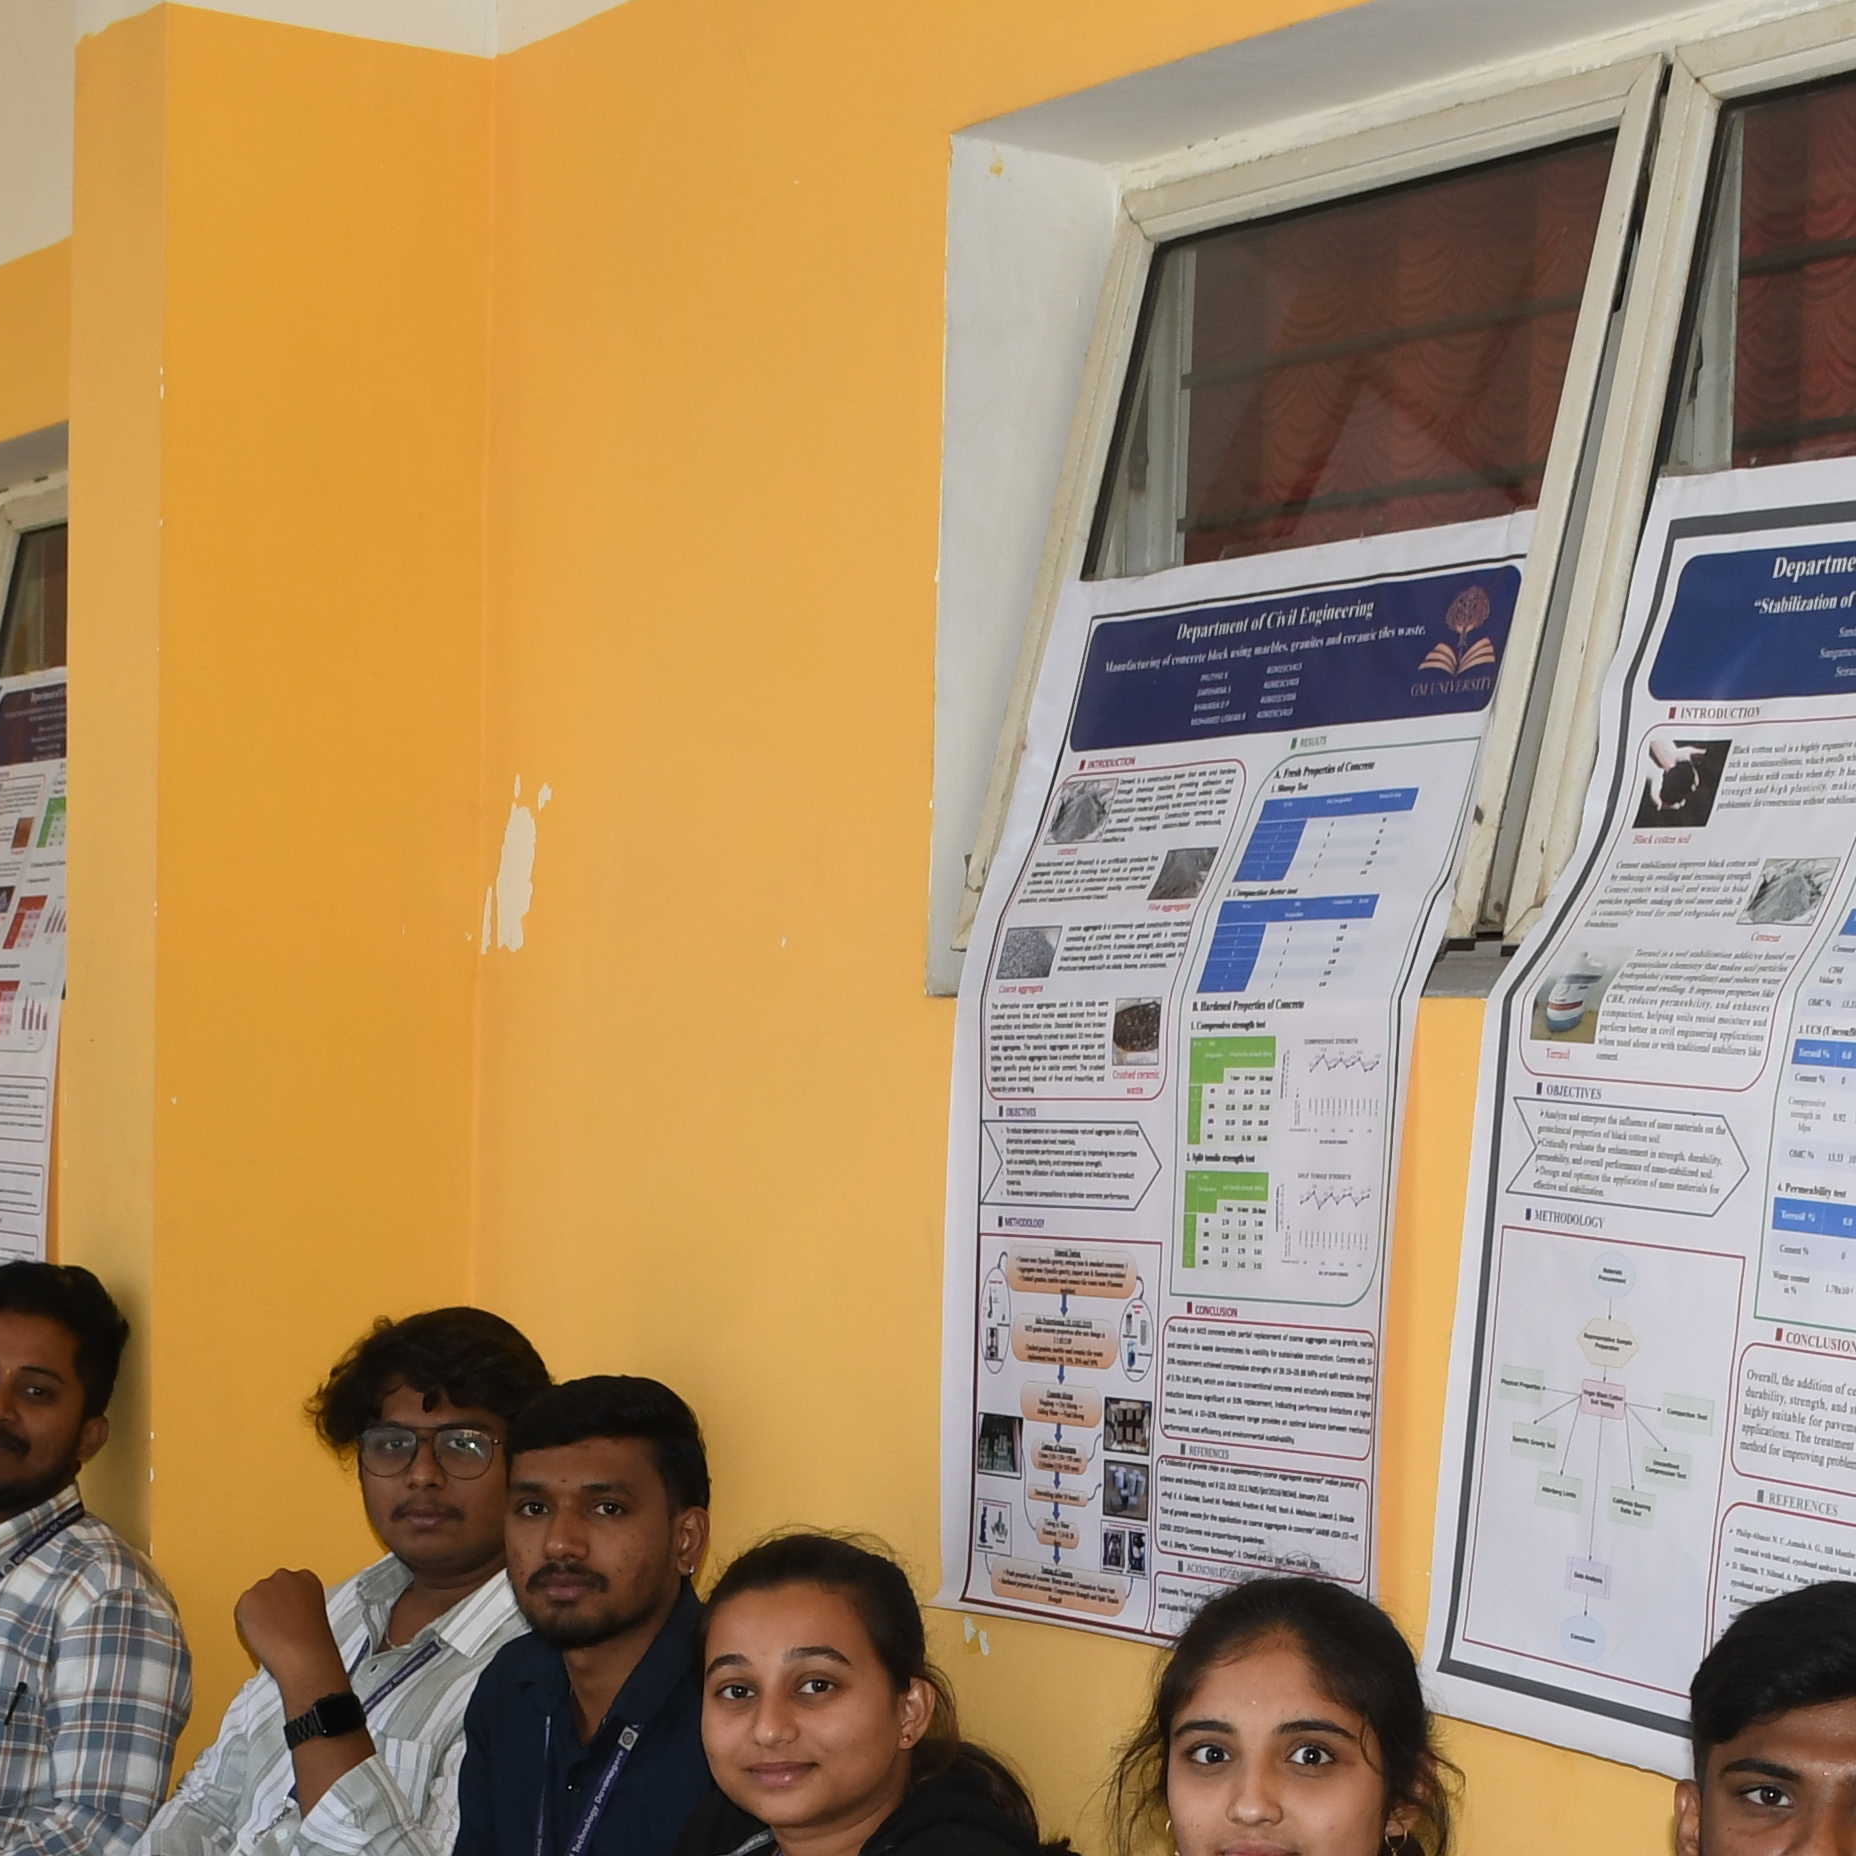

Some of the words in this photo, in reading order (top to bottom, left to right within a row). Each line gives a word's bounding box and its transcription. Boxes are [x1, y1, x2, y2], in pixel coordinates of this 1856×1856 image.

[1754, 593, 1837, 613] “Stabilization
[1840, 590, 1856, 608] of
[1176, 617, 1249, 643] Department
[1250, 612, 1266, 631] of
[1266, 609, 1297, 629] Civil
[1299, 602, 1374, 626] Engineering
[1410, 682, 1428, 696] GM
[1430, 677, 1491, 694] UNIVERSITY
[1680, 706, 1760, 719] INTRODUCTION
[1546, 1084, 1601, 1099] OBJECTIVES
[1535, 1209, 1603, 1229] METHODOLOGY
[1746, 1368, 1779, 1385] Overall,
[1781, 1374, 1795, 1387] the
[1796, 1377, 1833, 1393] addition
[1834, 1383, 1847, 1395] of
[1745, 1386, 1787, 1406] durability,
[1789, 1396, 1828, 1411] strength,
[1830, 1401, 1847, 1413] and
[1743, 1403, 1769, 1421] highly
[1771, 1411, 1806, 1425] suitable
[1808, 1414, 1823, 1427] for
[1768, 1492, 1838, 1517] REFERENCES
[571, 1804, 599, 1852] Technology
[594, 1749, 624, 1804] Davanagere
